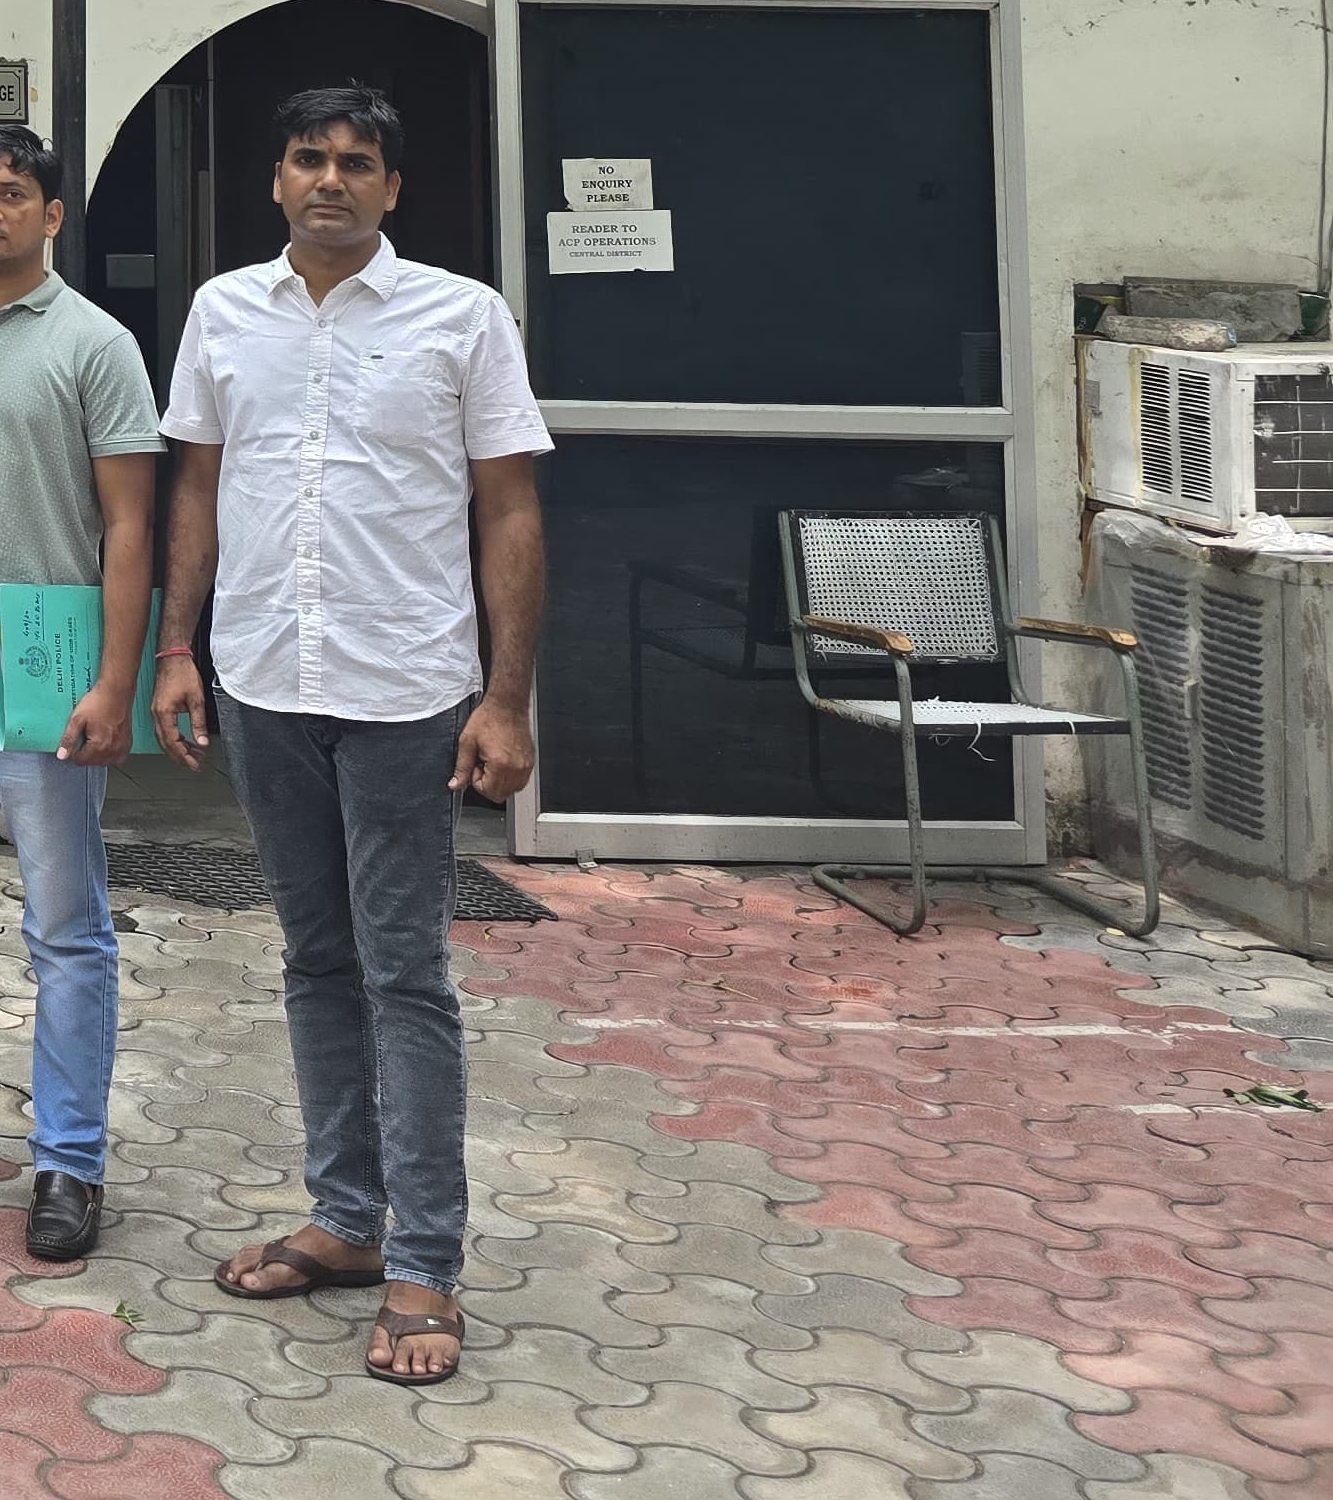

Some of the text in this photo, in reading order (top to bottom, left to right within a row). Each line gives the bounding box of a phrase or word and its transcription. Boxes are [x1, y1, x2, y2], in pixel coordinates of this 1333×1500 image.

[598, 166, 615, 175] NO
[581, 179, 633, 190] ENQUIRY
[586, 193, 630, 203] PLEASE
[572, 224, 638, 234] READER TO
[558, 237, 657, 247] ACP OPERATIONS
[54, 633, 63, 664] POLICE
